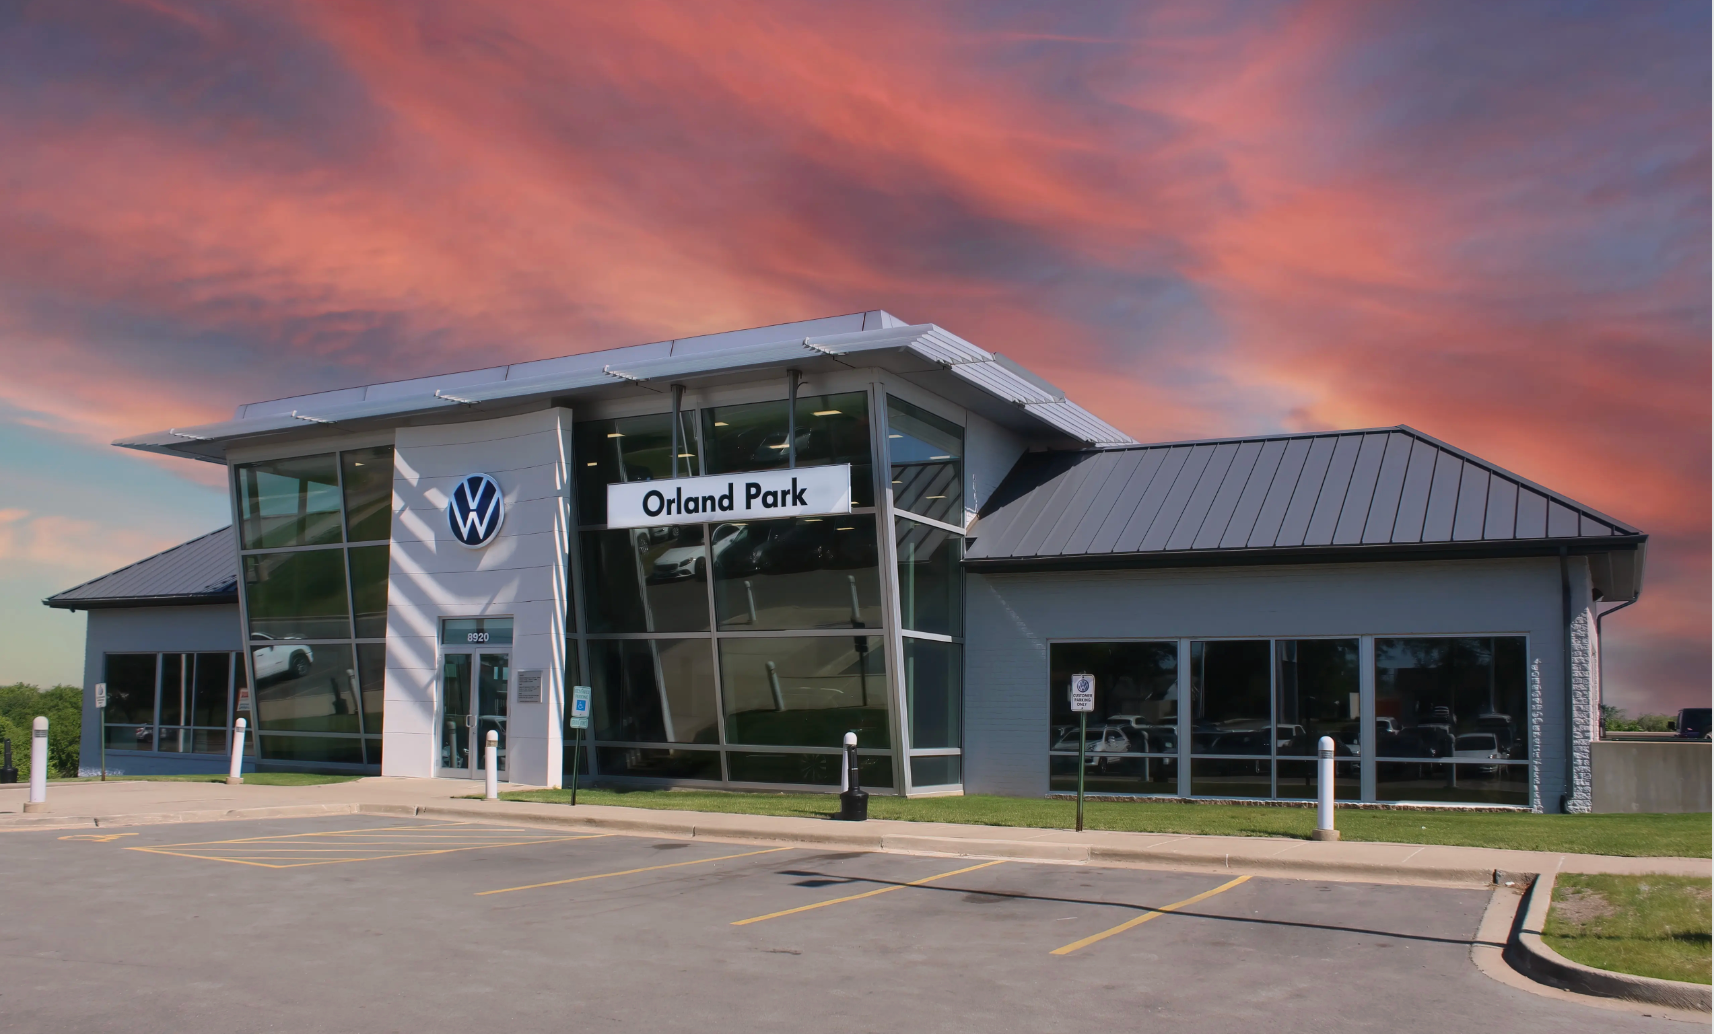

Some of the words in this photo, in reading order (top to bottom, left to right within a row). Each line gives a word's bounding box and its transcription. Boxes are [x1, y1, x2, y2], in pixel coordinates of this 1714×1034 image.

[448, 473, 504, 549] VW
[642, 483, 734, 517] Orland
[745, 477, 808, 510] Park
[467, 632, 490, 642] 8920
